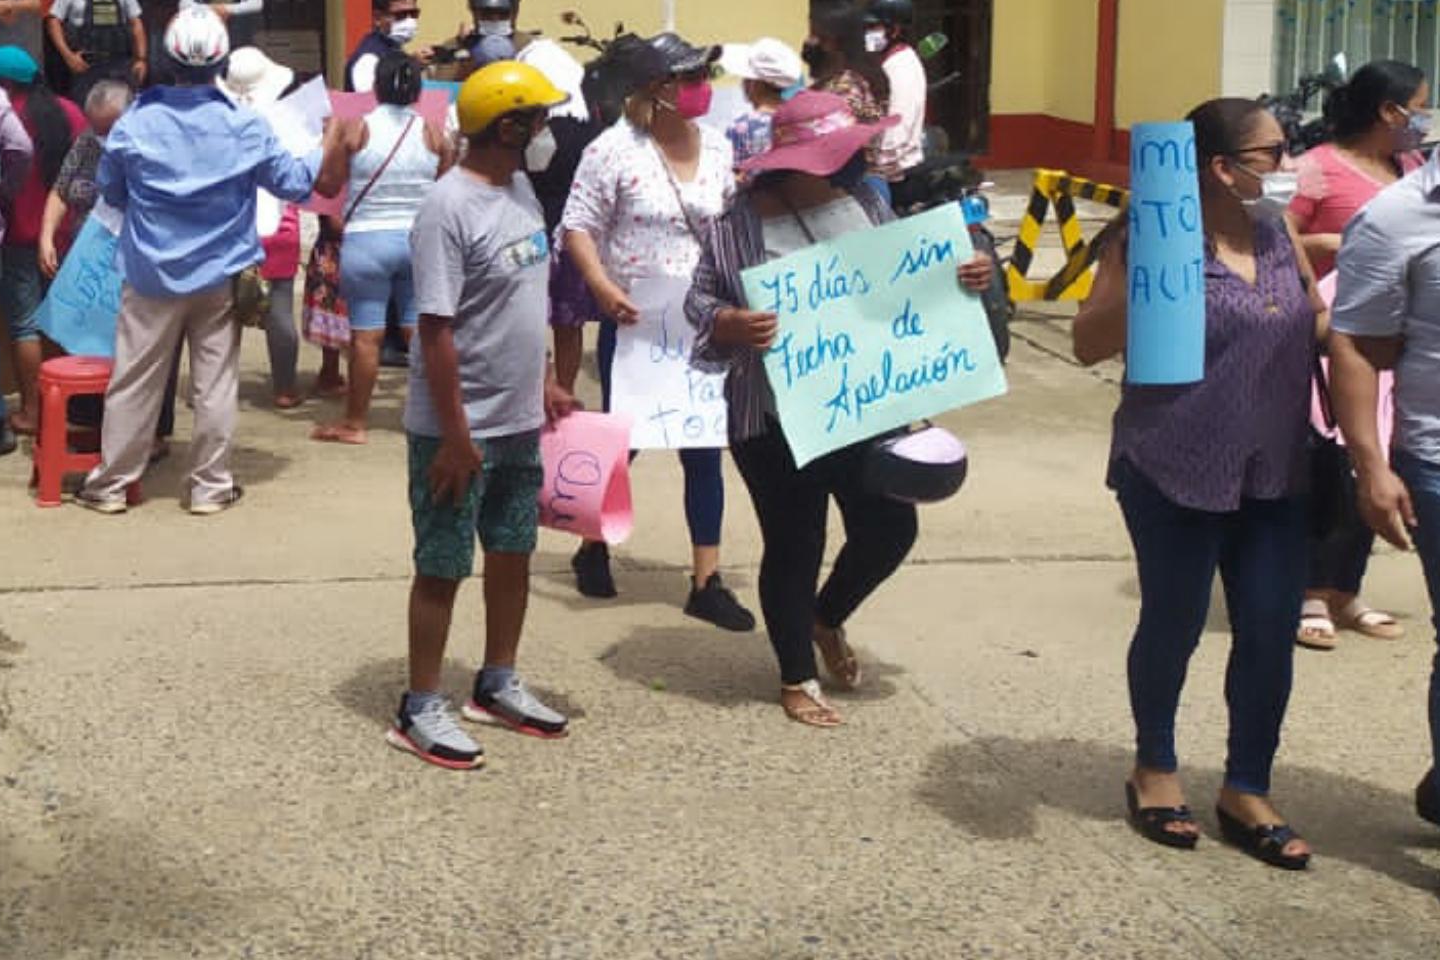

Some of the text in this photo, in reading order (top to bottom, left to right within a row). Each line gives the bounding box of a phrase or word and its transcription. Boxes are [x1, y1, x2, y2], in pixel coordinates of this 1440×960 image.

[760, 239, 953, 314] 75 días sin
[892, 300, 926, 340] de
[824, 344, 977, 432] Apelación
